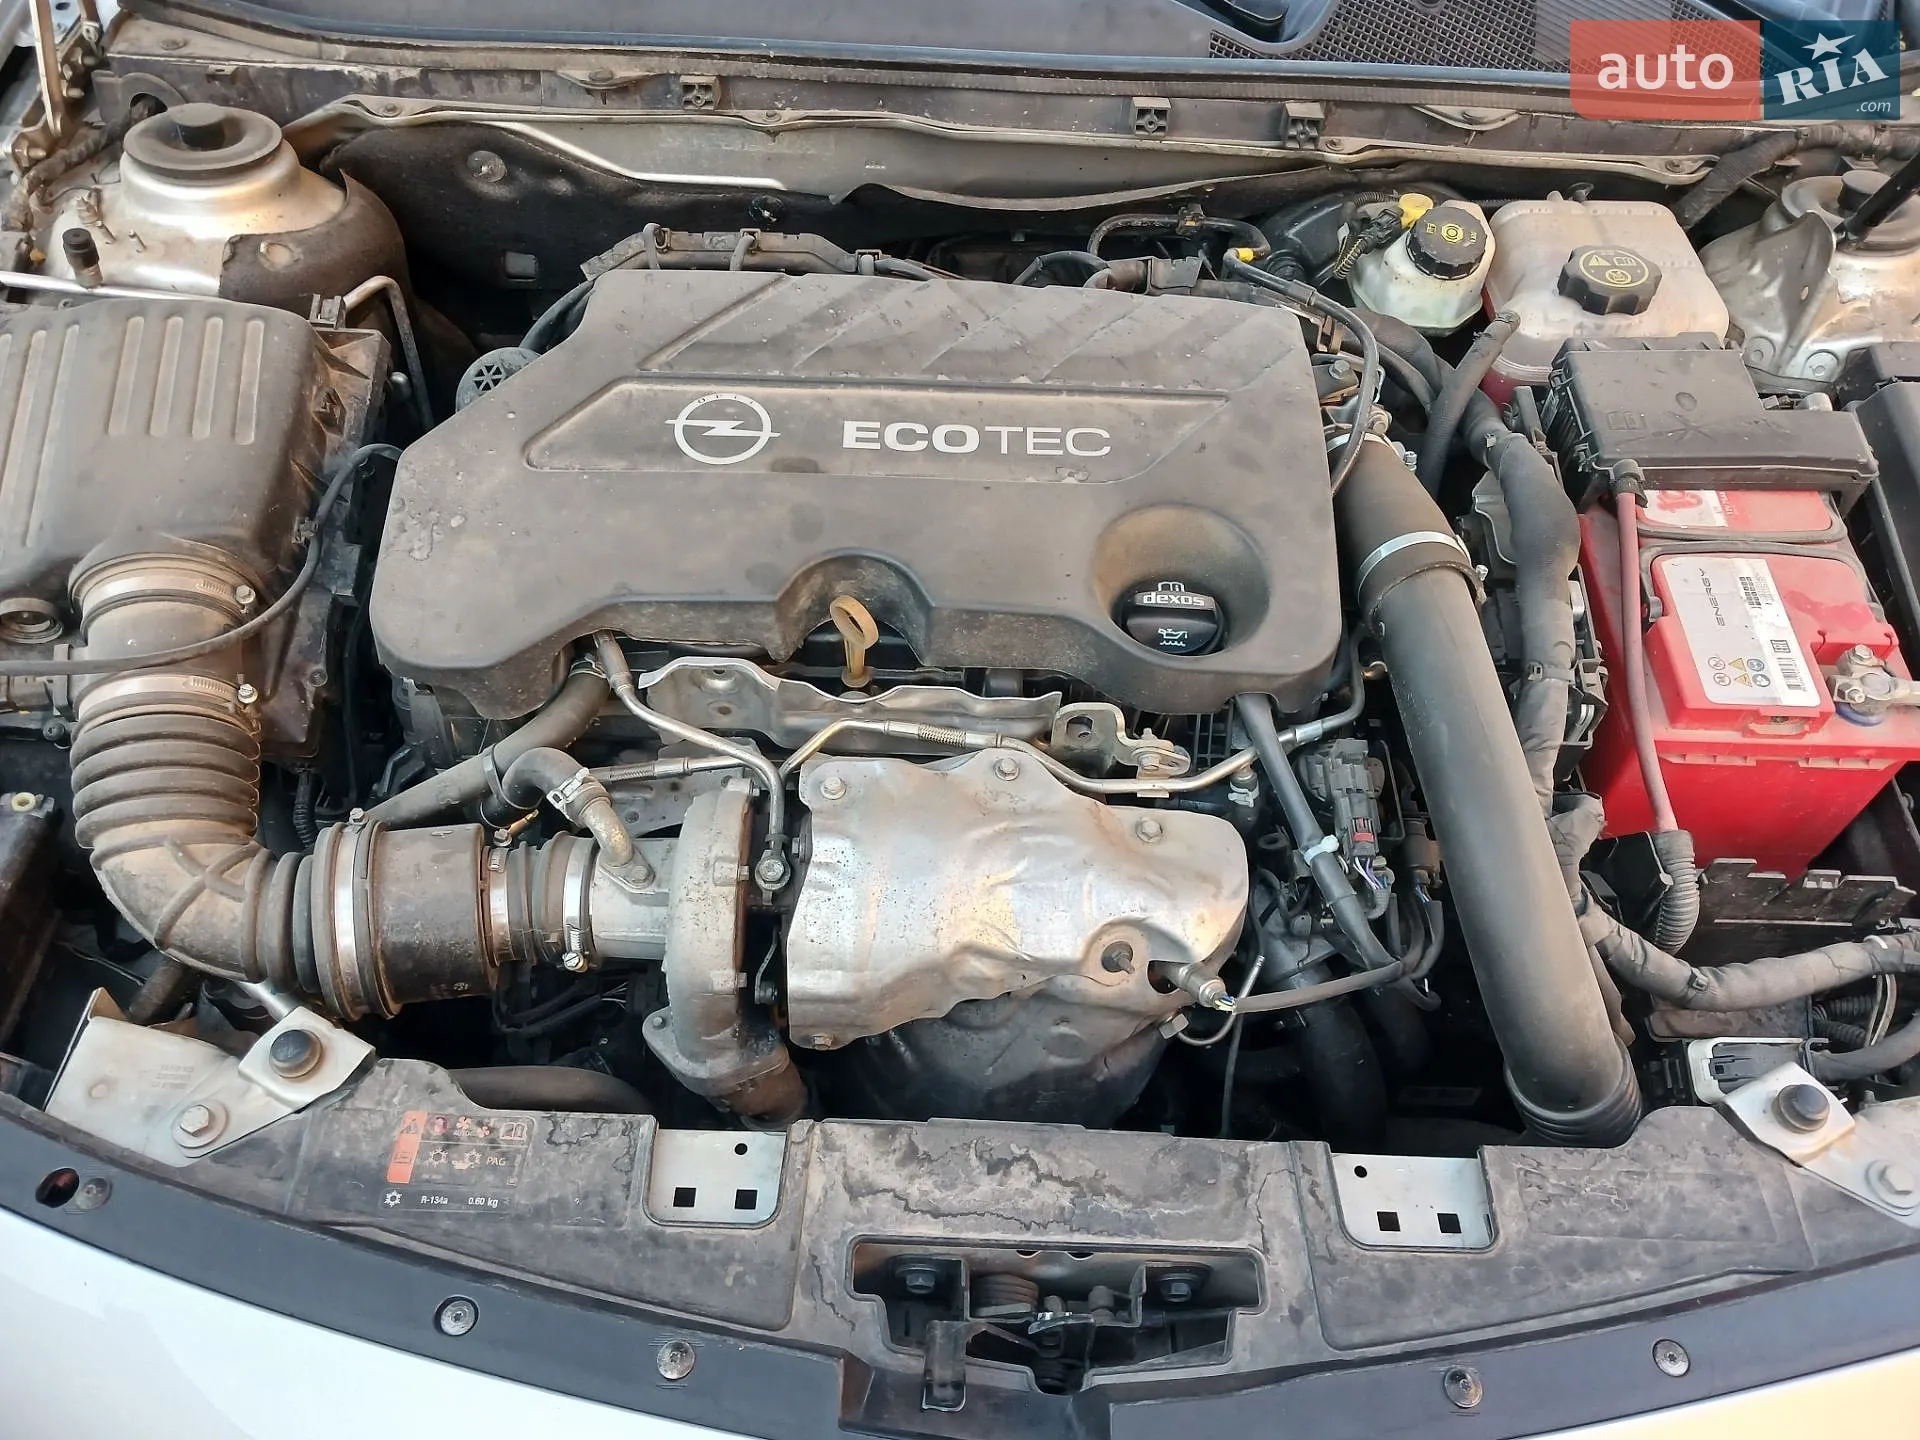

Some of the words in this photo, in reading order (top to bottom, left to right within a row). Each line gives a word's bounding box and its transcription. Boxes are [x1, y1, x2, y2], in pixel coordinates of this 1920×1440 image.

[841, 419, 1112, 457] ECOTEC
[1142, 591, 1205, 606] dexos
[1698, 567, 1726, 627] ENERGY
[486, 1157, 507, 1166] PAG
[420, 1195, 449, 1205] R-134a
[468, 1196, 486, 1206] 0.60
[487, 1197, 499, 1208] kg
